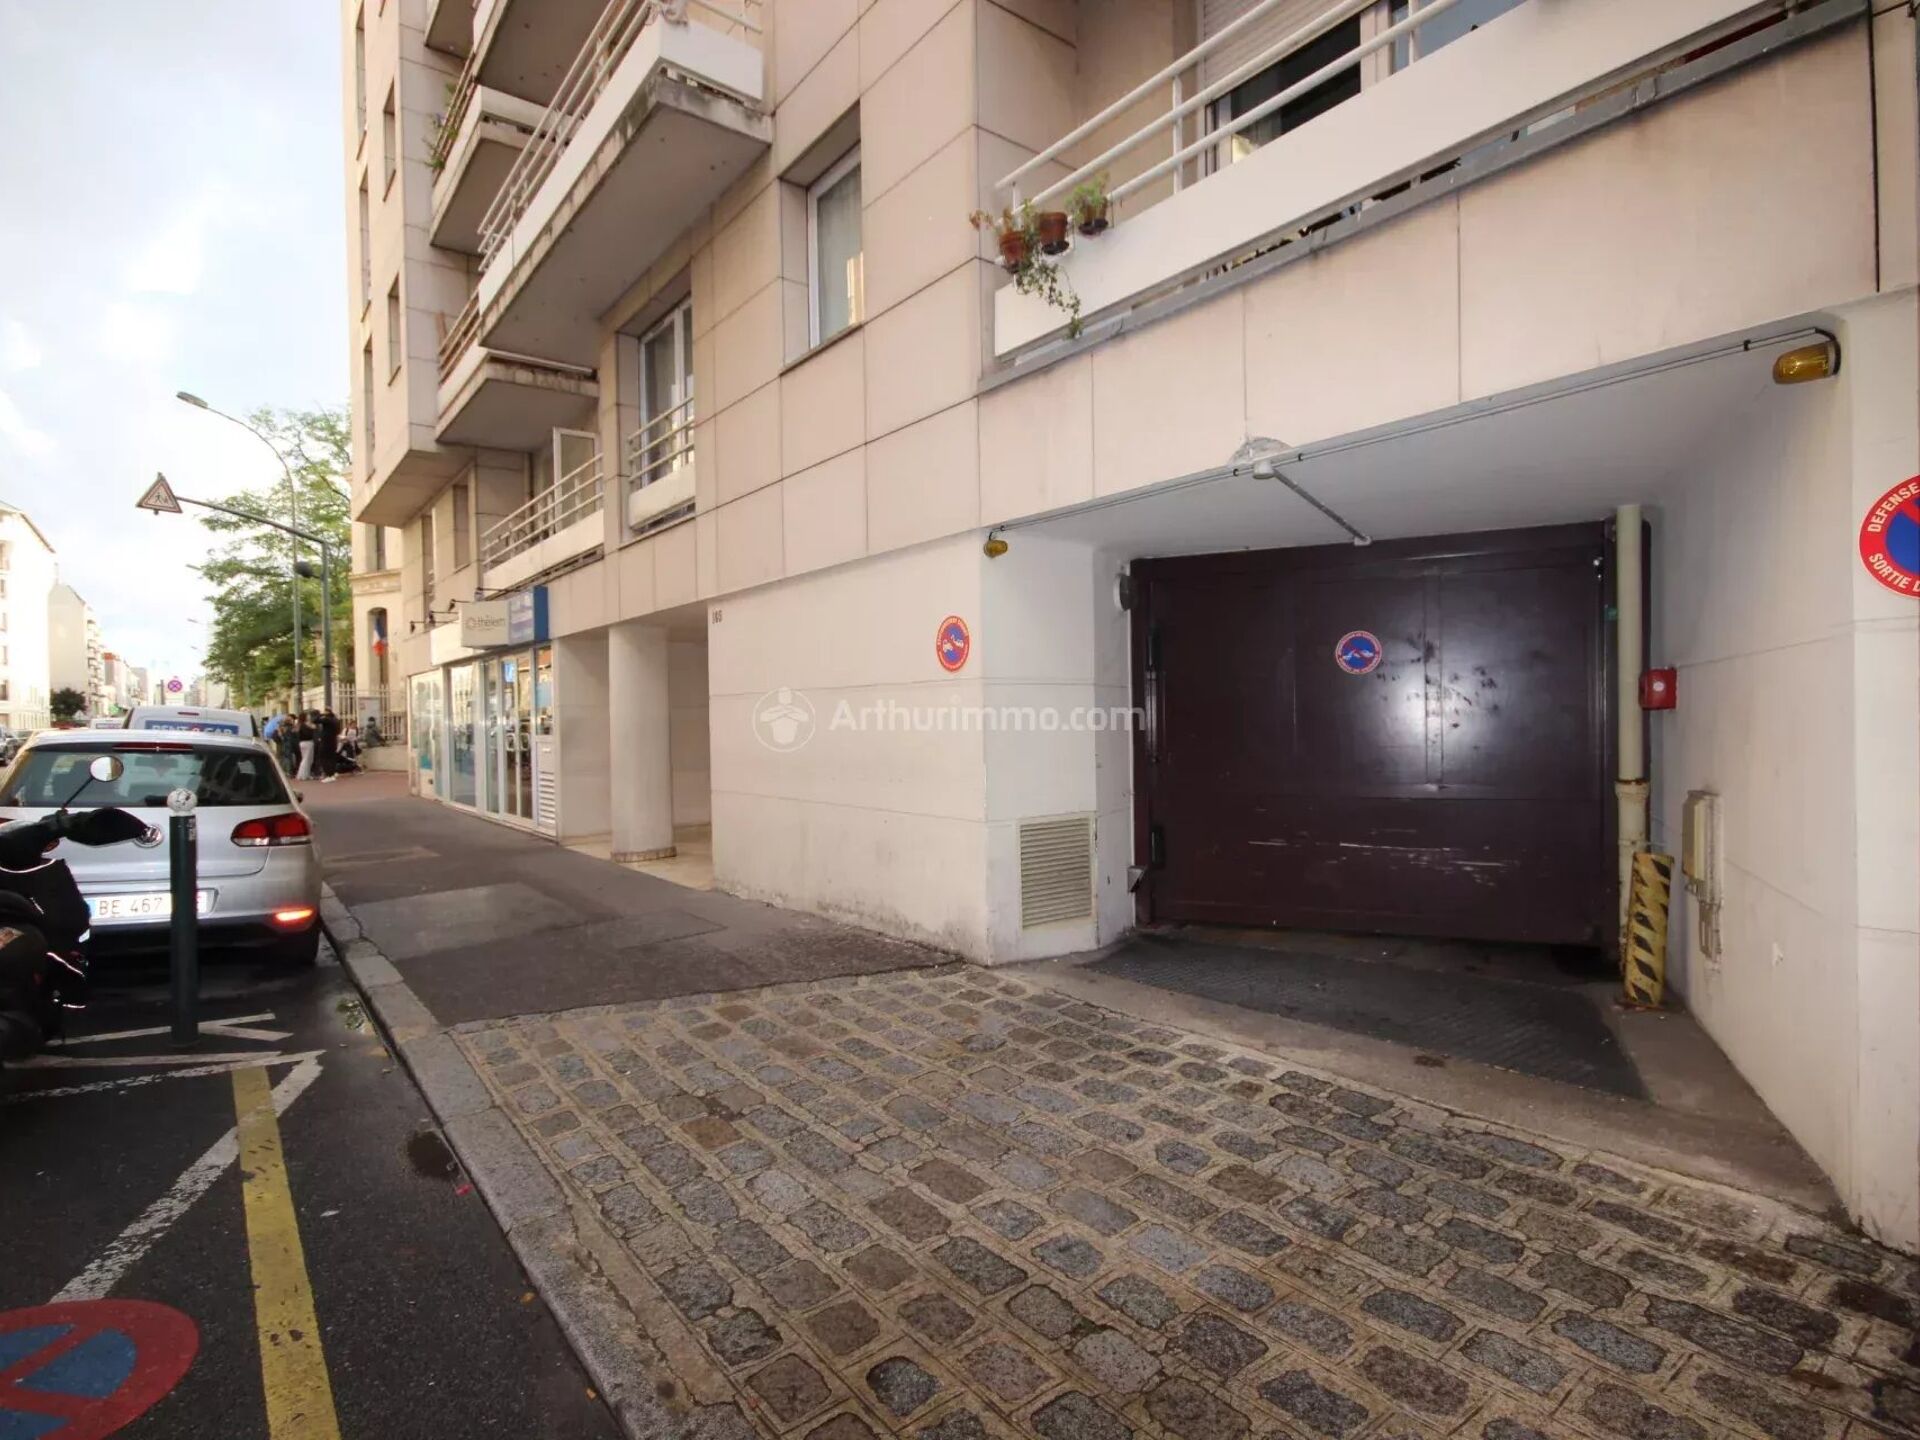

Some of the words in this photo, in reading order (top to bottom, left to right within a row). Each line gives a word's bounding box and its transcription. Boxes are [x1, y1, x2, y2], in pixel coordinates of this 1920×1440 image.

[1867, 482, 1920, 533] DEFENSE
[1868, 553, 1912, 589] SORTIE
[99, 900, 121, 916] BE
[130, 897, 163, 913] 467
